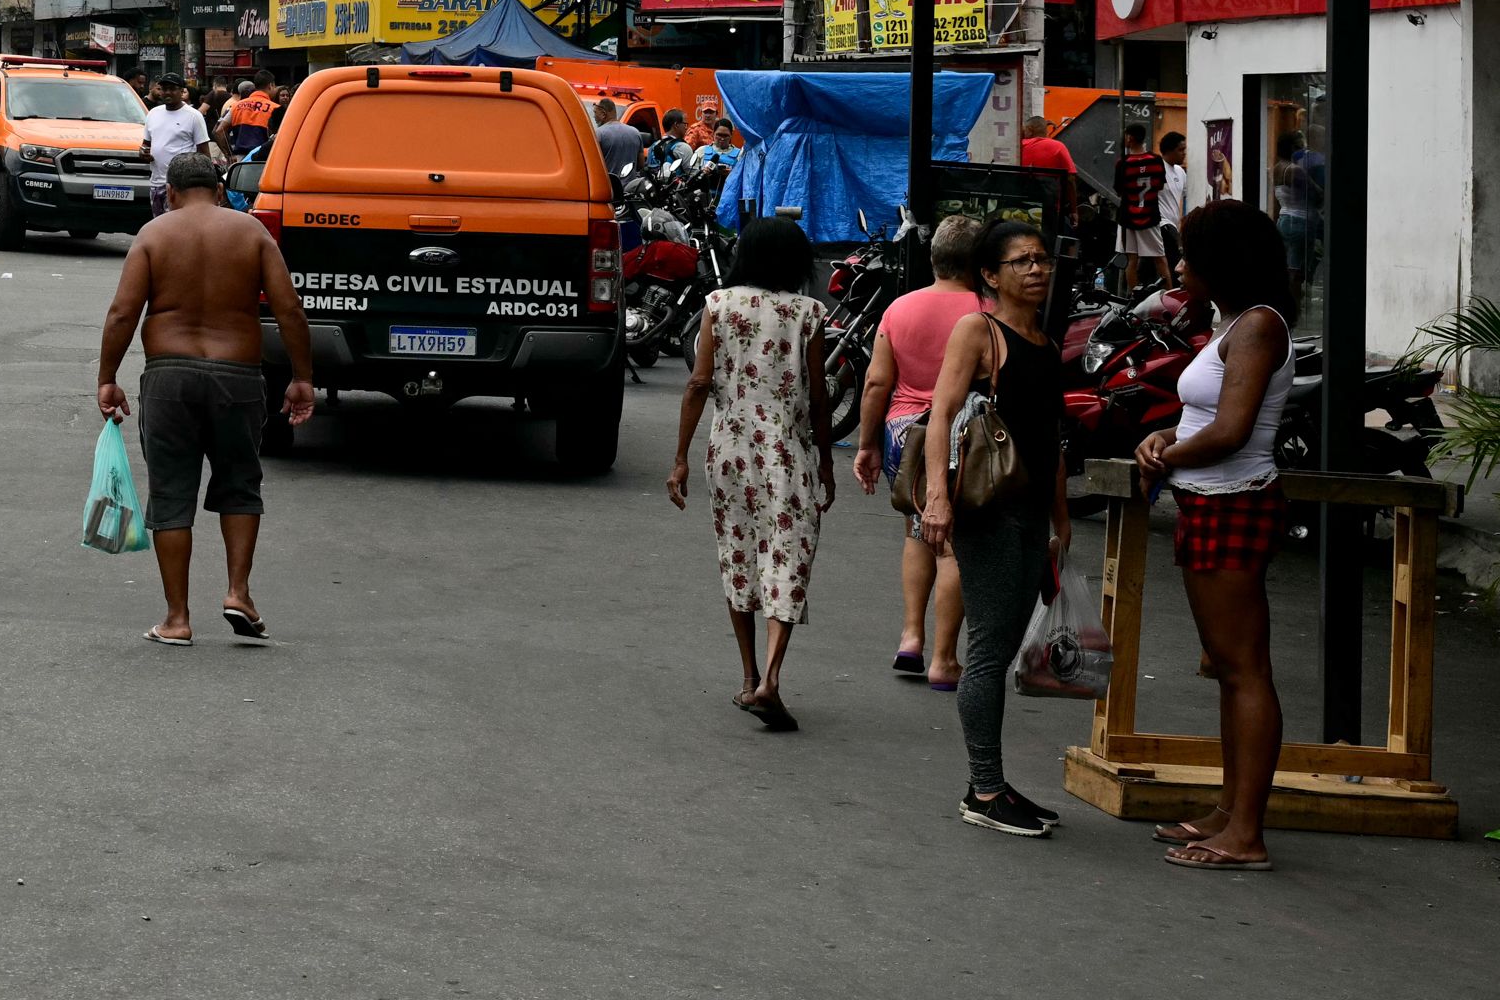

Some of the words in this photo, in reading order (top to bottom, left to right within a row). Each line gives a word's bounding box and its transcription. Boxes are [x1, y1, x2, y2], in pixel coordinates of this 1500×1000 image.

[248, 8, 268, 38] Favo
[285, 0, 327, 37] BARATO
[390, 22, 432, 31] ENTREGAS
[886, 20, 908, 32] (21)
[934, 16, 977, 30] 42-7210
[887, 33, 909, 45] (21)
[936, 29, 985, 42] 42-2888
[25, 180, 52, 189] CBMERJ
[304, 213, 361, 226] DGDEC
[291, 273, 379, 291] DEFESA
[386, 276, 448, 293] CIVIL
[456, 278, 578, 297] ESTADUAL
[487, 302, 578, 317] ARDC-031
[396, 334, 466, 352] LTX9H59
